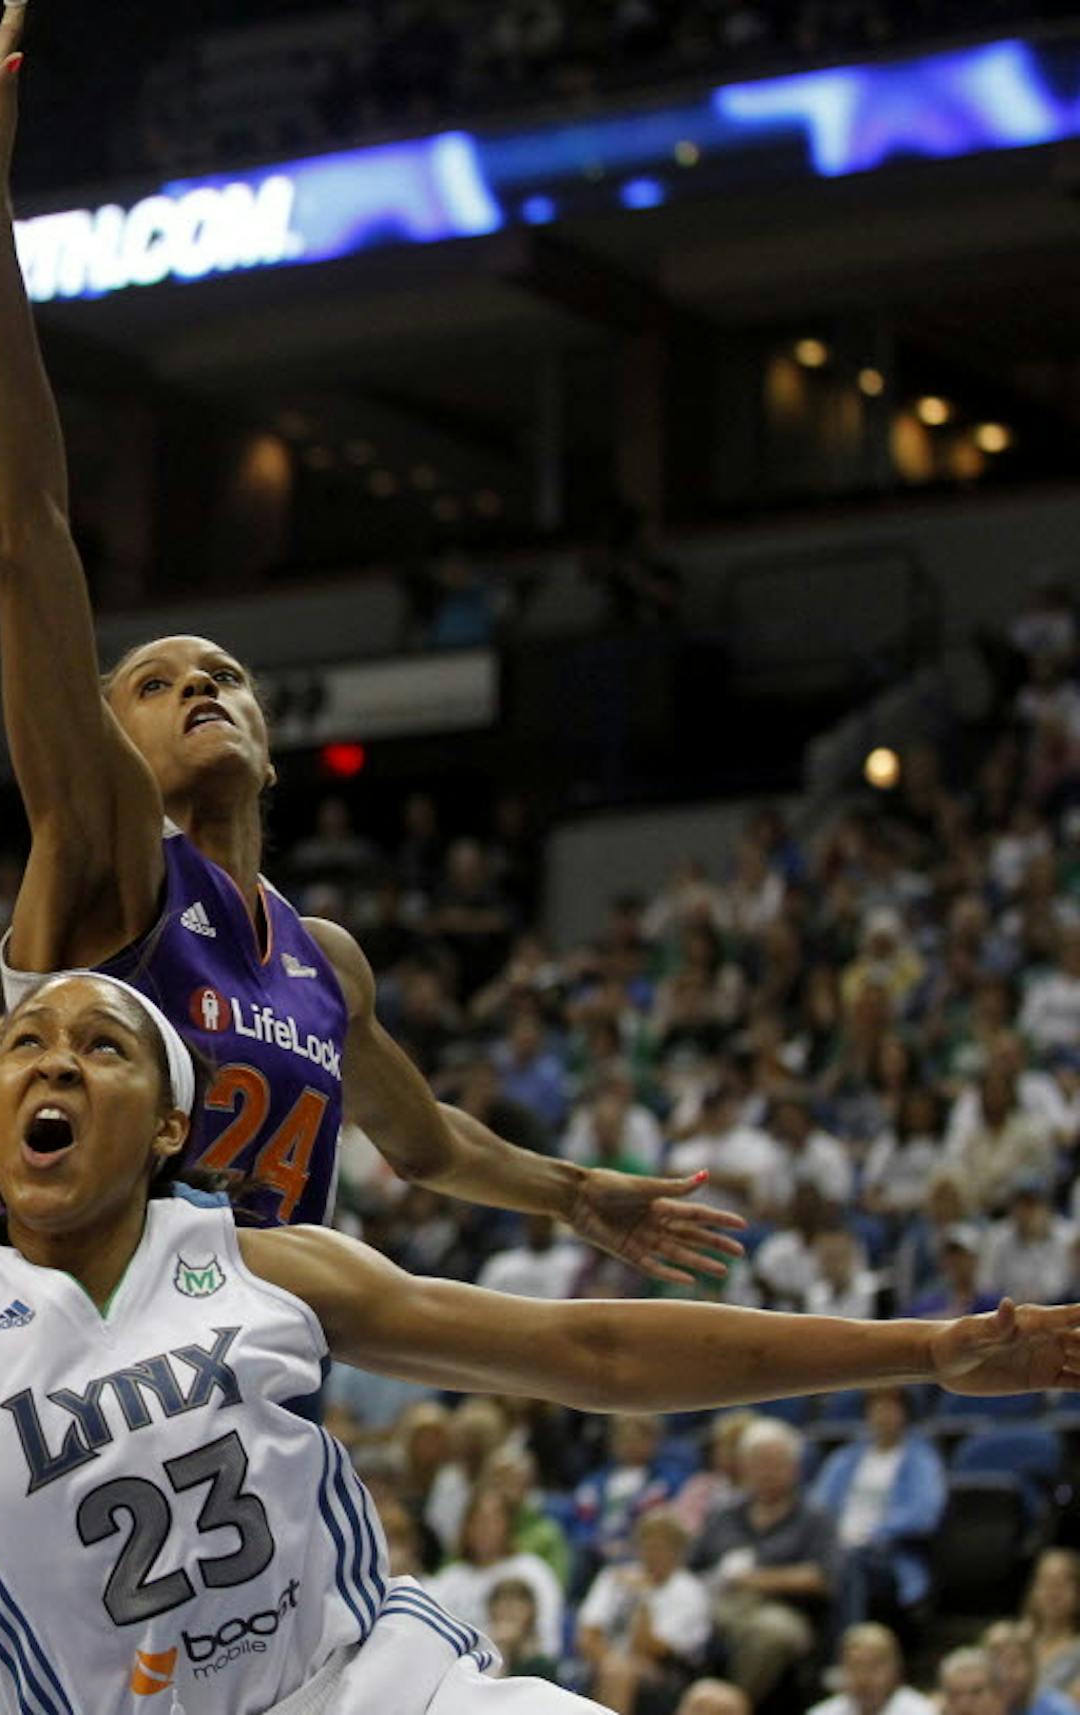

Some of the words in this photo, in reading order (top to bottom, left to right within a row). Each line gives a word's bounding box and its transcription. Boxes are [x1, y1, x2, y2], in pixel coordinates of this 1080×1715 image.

[231, 997, 343, 1081] LifeLock
[194, 1063, 330, 1224] 24
[75, 1428, 276, 1626] 23
[192, 1639, 268, 1681] mobile
